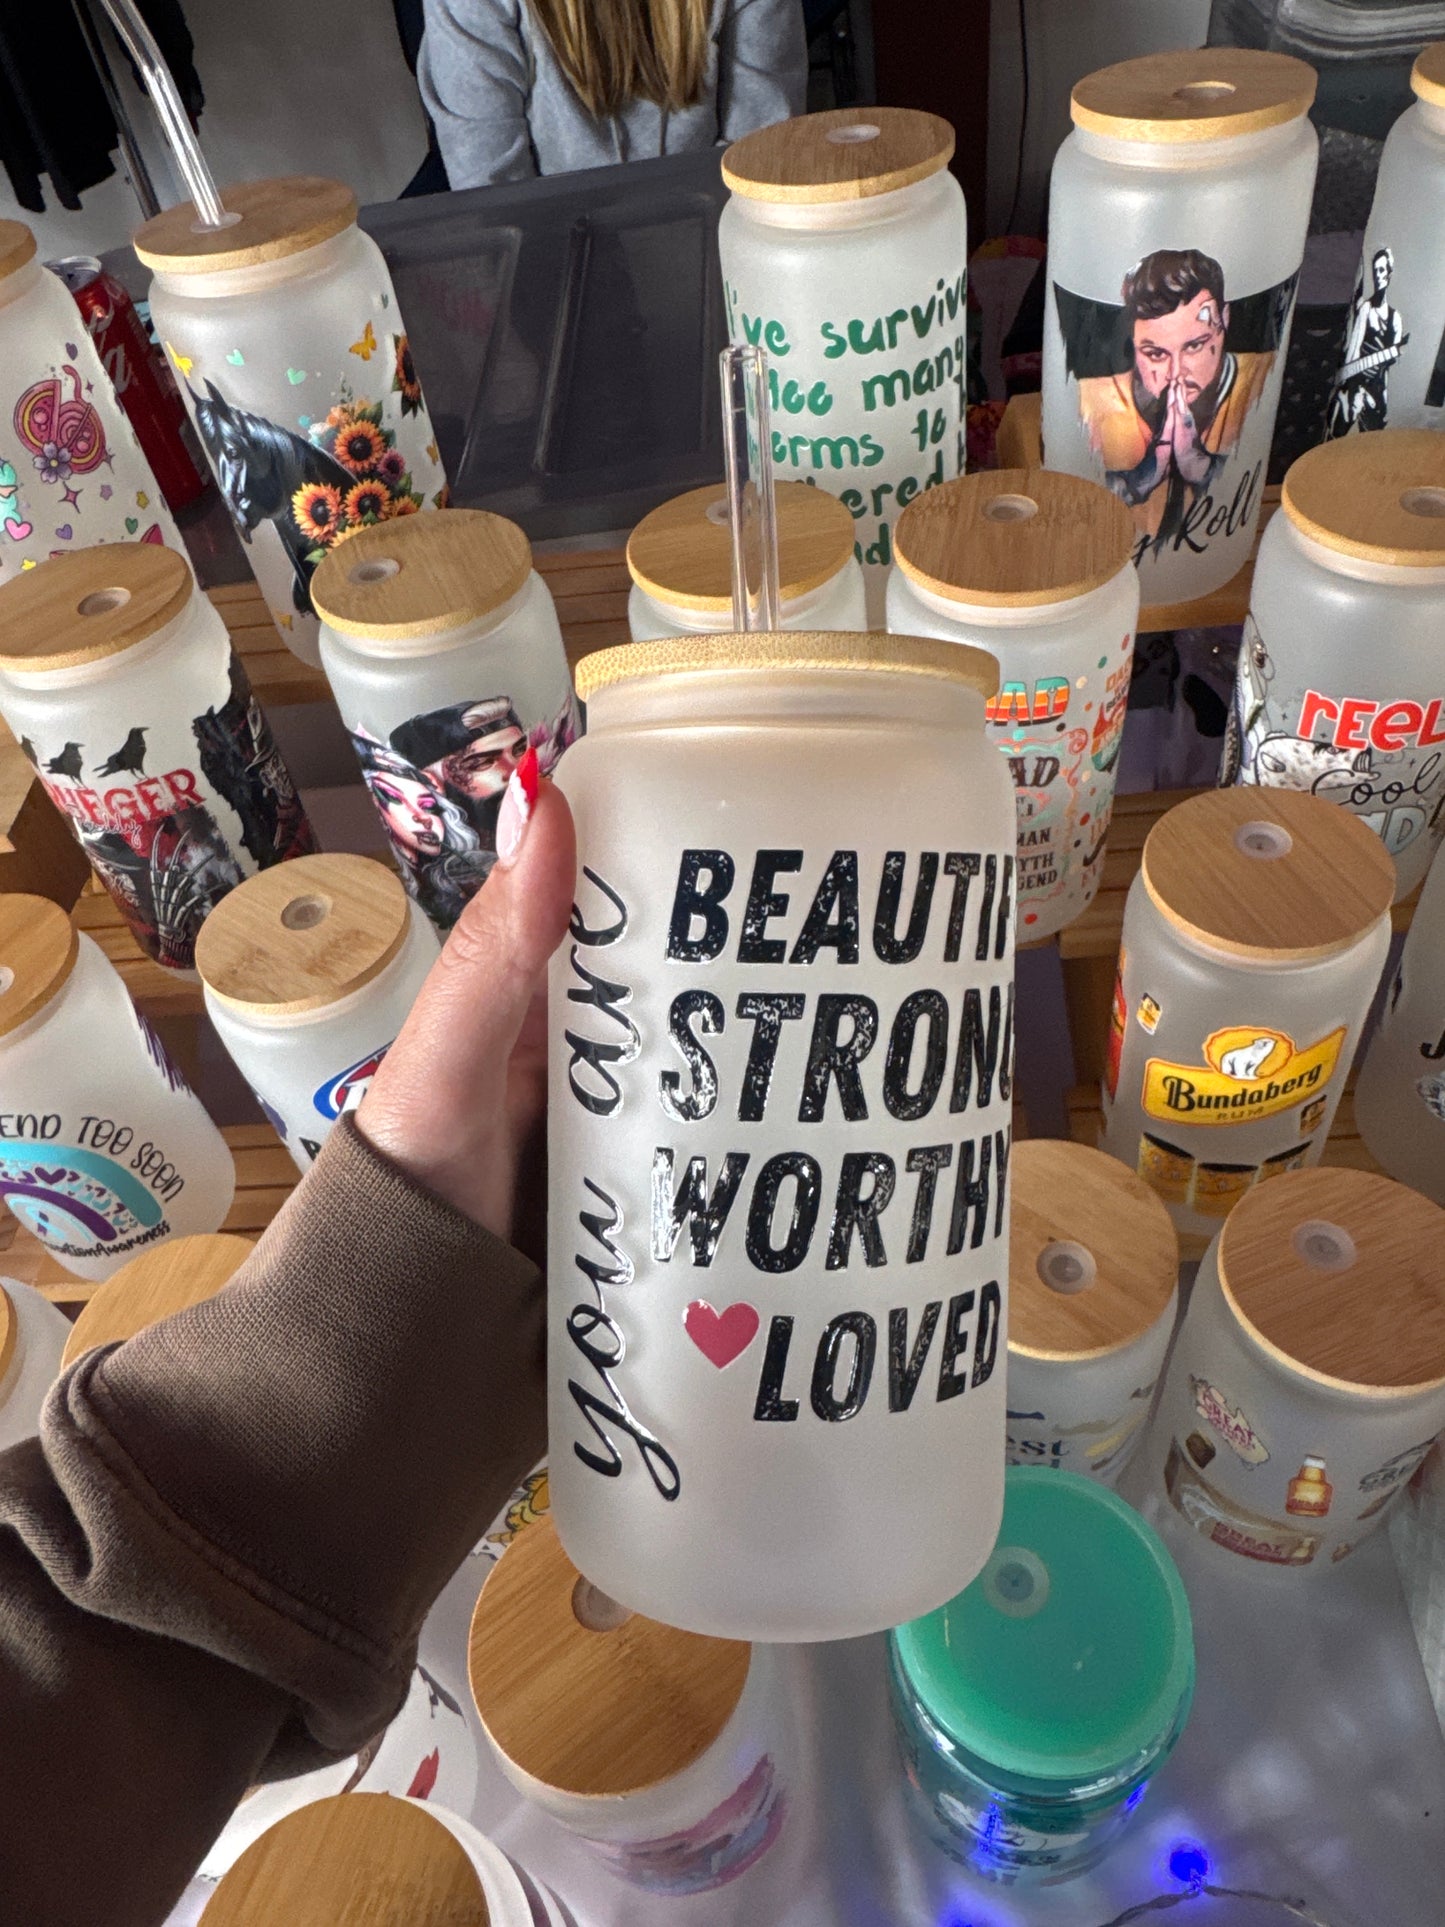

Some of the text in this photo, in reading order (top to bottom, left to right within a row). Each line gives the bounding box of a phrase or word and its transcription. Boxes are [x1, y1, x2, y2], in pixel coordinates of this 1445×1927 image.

[770, 430, 884, 470] orms
[911, 408, 946, 452] to
[1008, 756, 1060, 788] AD
[1311, 752, 1442, 806] Cool
[1017, 852, 1054, 873] YTH
[1017, 870, 1058, 891] GEND
[1162, 1063, 1322, 1112] Bundaberg
[564, 864, 681, 1502] you are
[753, 1280, 1002, 1423] LOVED
